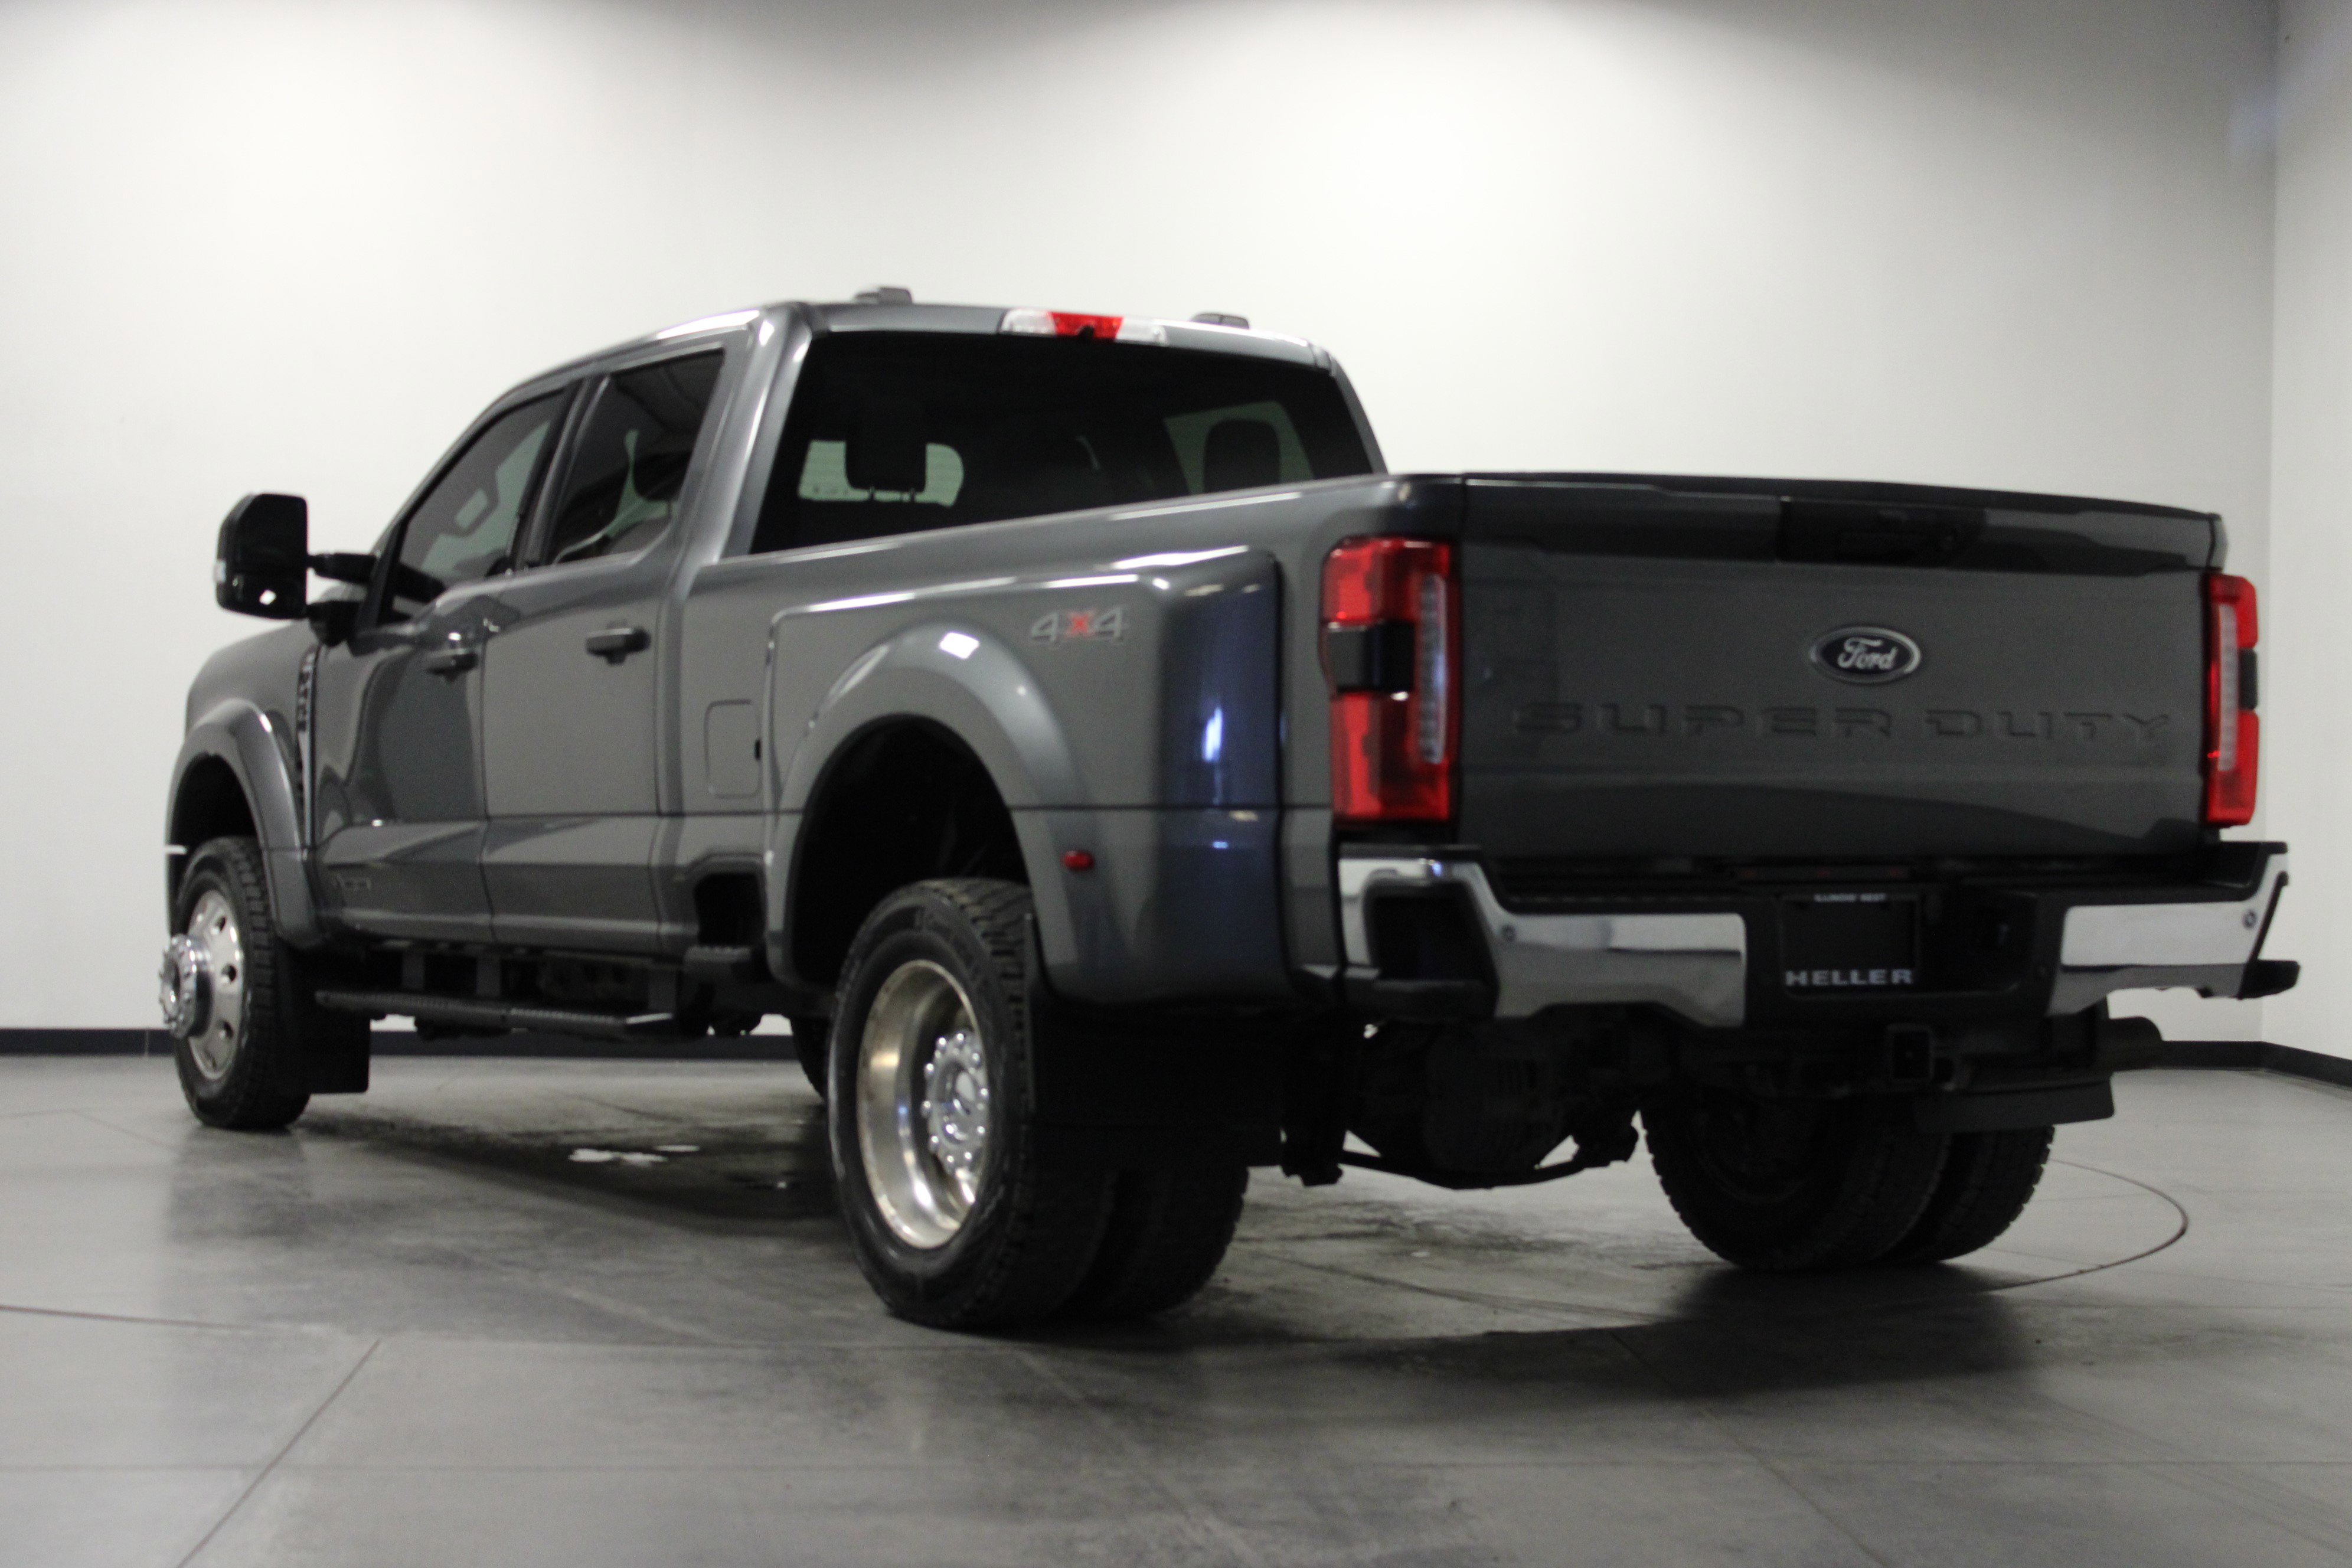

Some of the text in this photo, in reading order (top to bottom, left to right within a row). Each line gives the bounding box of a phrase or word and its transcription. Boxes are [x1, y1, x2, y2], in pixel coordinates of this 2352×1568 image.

[1837, 636, 1899, 670] Ford
[1511, 701, 2170, 741] SUPER DUTY
[1785, 968, 1913, 986] HELLER
